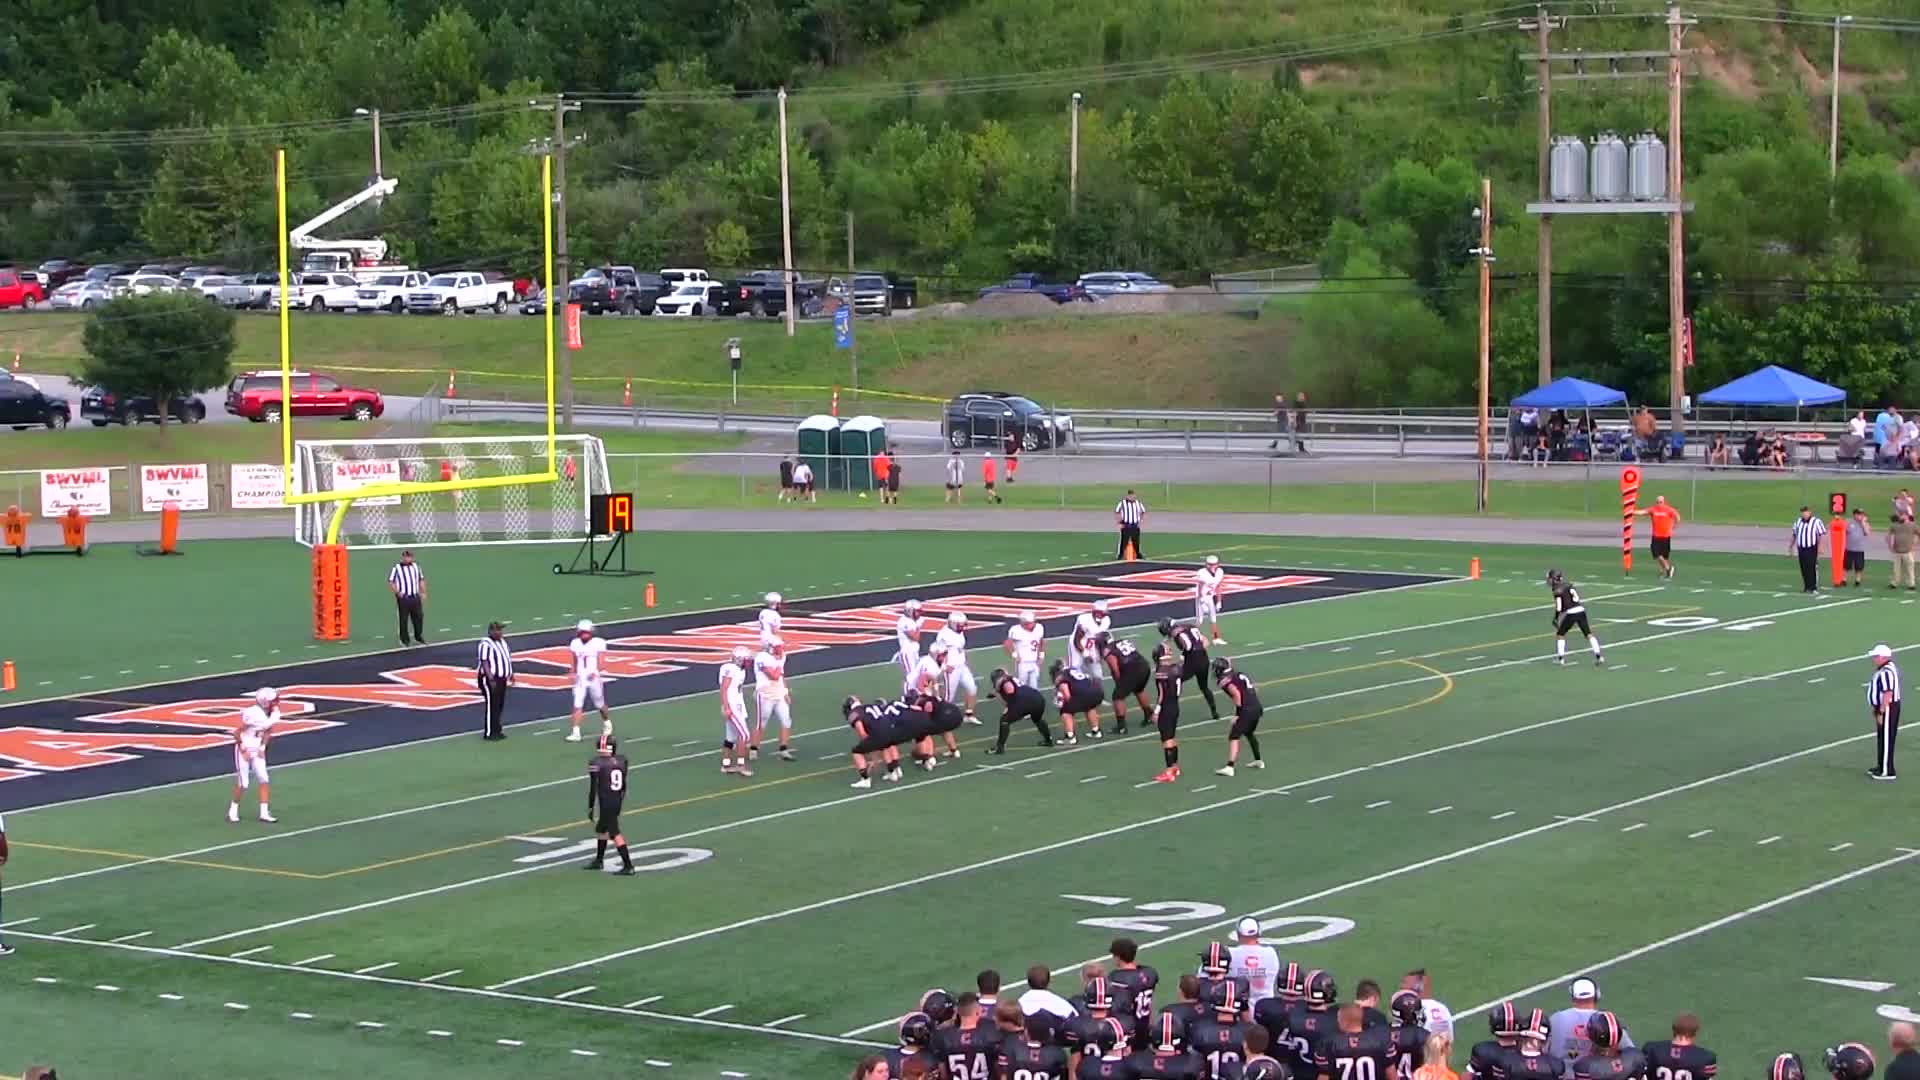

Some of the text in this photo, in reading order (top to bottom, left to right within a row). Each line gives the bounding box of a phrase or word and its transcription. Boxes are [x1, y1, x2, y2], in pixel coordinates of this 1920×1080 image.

[608, 497, 629, 532] 19
[333, 551, 342, 636] TIGERS
[610, 769, 623, 791] 9
[1076, 900, 1356, 945] 20
[949, 1053, 990, 1080] 54
[1336, 1056, 1376, 1080] 70
